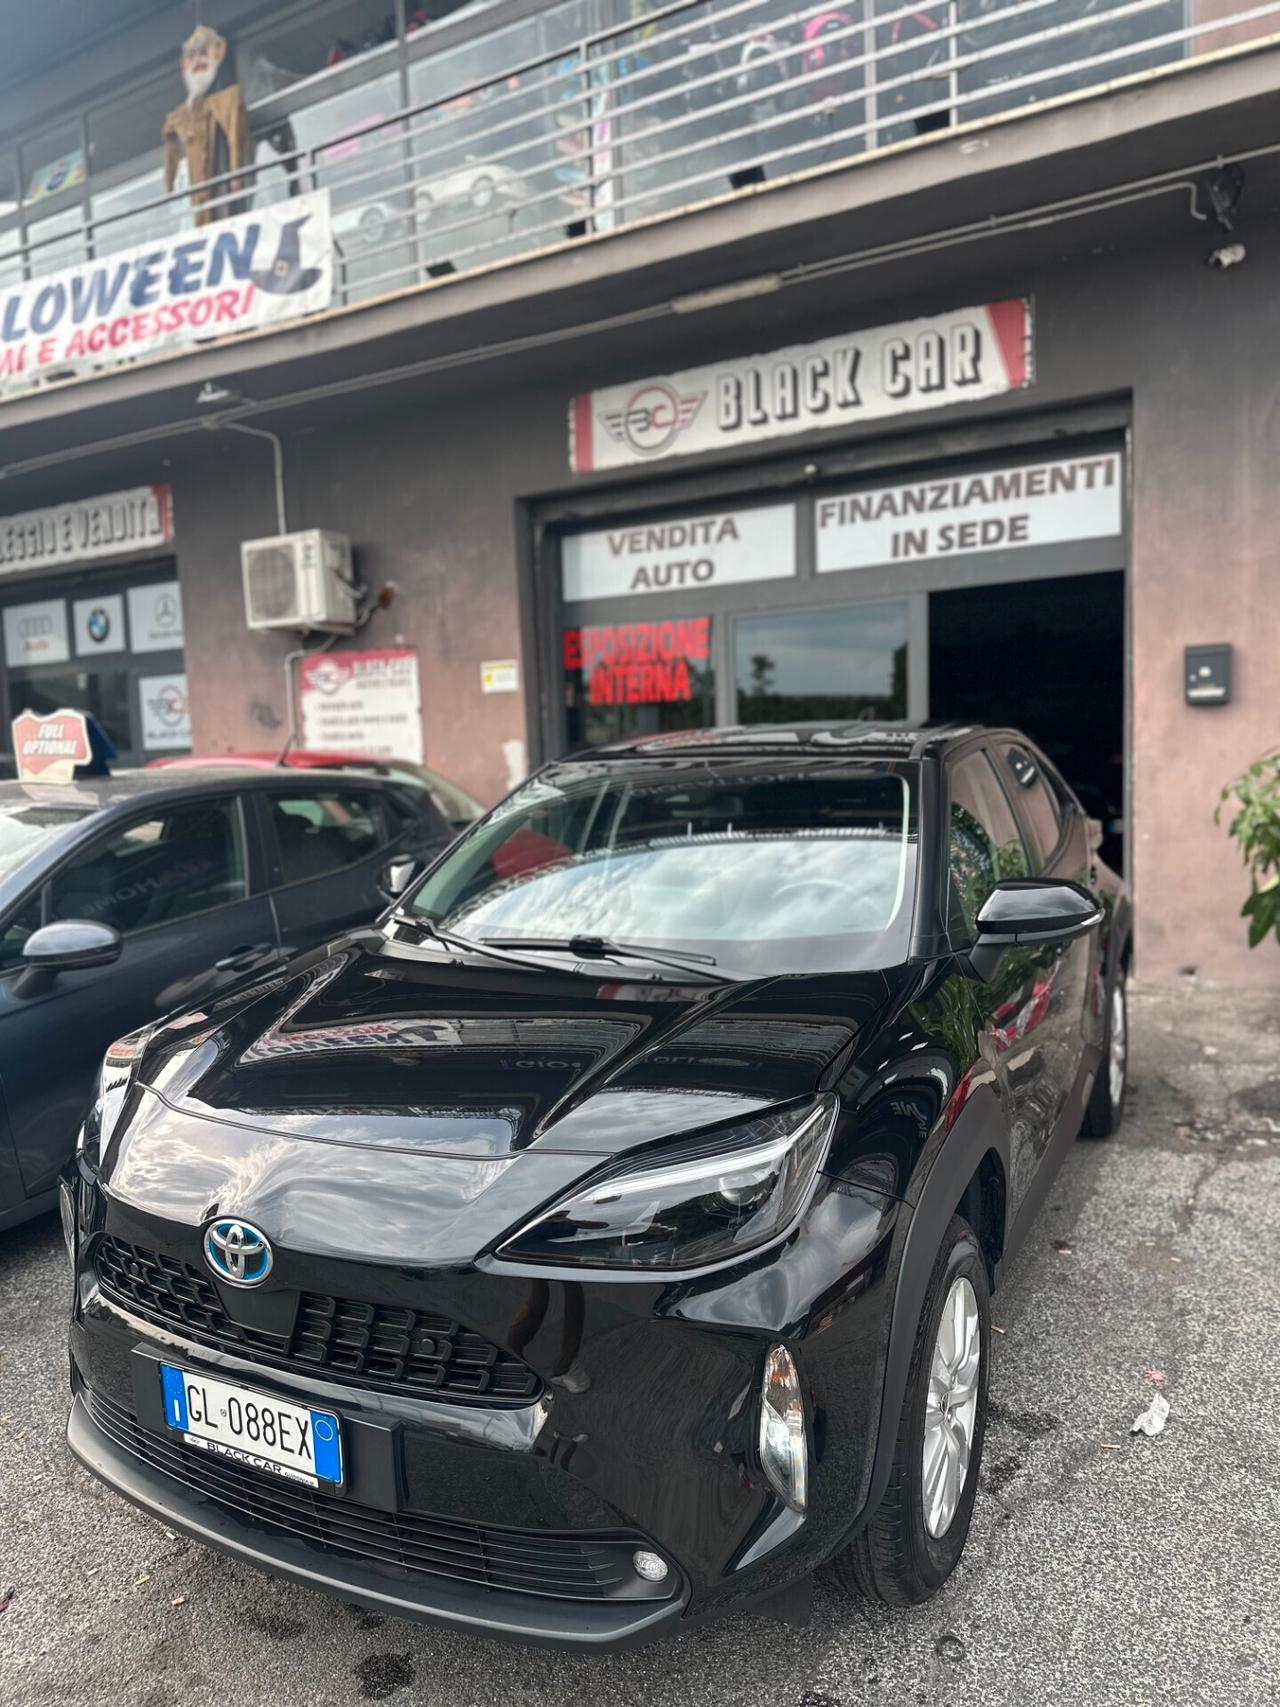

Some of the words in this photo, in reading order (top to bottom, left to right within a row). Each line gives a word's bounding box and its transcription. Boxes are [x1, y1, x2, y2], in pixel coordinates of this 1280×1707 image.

[37, 337, 58, 365] E
[65, 283, 257, 360] ACCESSORI
[716, 345, 862, 432] BLACK
[881, 322, 983, 398] CAR
[819, 458, 1115, 529] FINANZIAMENTI
[607, 517, 740, 557] VENDITA
[891, 528, 928, 558] IN
[937, 514, 1030, 552] SEDE
[630, 559, 716, 590] AUTO
[589, 660, 693, 706] INTERNA
[23, 740, 77, 755] OPTIONAL
[38, 723, 64, 739] FULL
[227, 1397, 313, 1460] 088EX
[206, 1441, 251, 1465] BLACK
[253, 1455, 283, 1475] CAR
